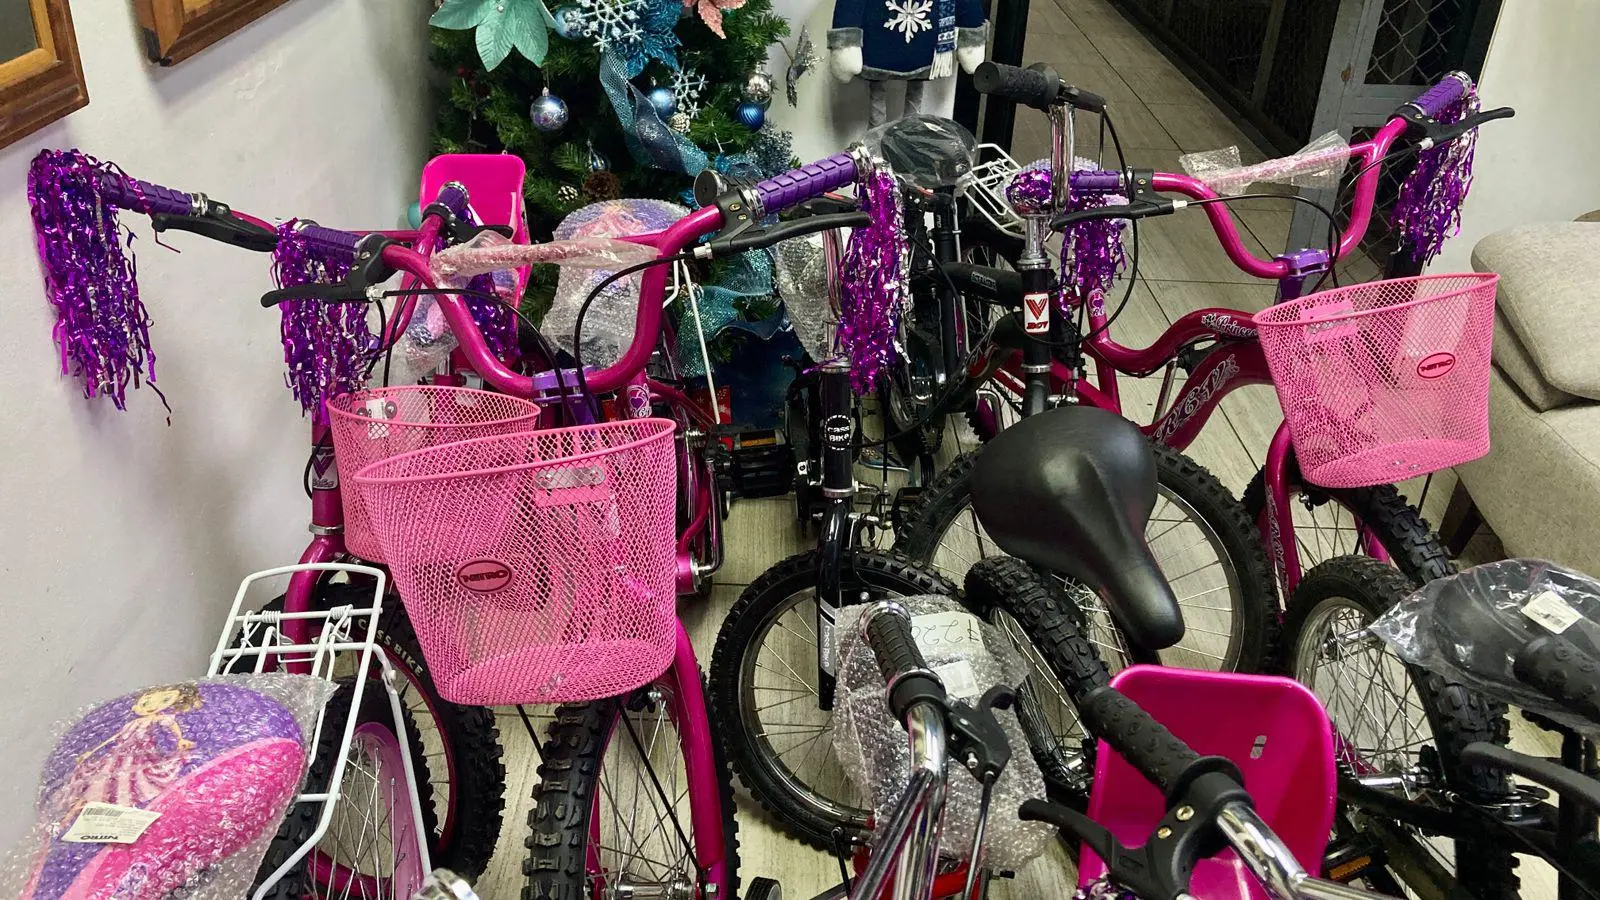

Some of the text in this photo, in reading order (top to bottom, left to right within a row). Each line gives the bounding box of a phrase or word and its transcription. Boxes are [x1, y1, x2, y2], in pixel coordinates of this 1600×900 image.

[1215, 315, 1258, 337] Princes
[1420, 359, 1453, 372] NITRO
[461, 570, 509, 583] NITRO
[358, 618, 424, 677] CSS BIKE
